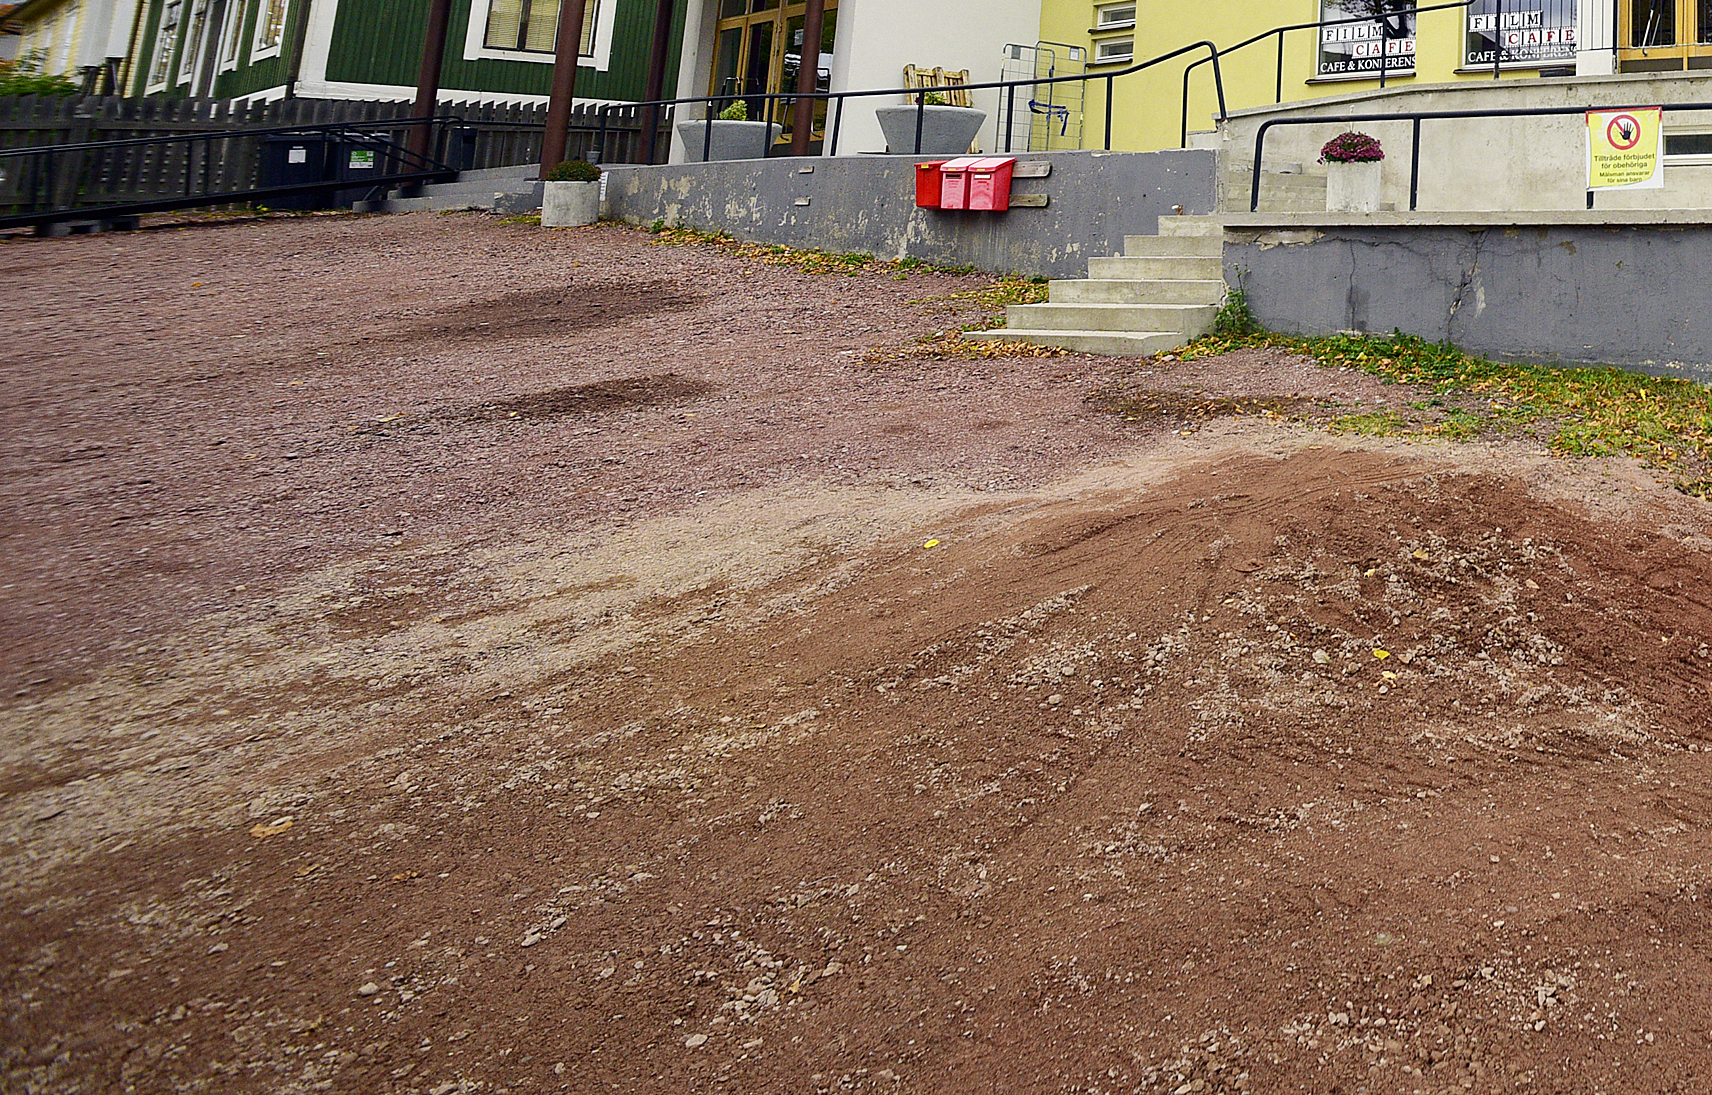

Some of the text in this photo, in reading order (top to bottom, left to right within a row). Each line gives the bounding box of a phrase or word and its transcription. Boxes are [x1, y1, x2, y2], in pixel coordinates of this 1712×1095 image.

[1326, 26, 1383, 41] FILM
[1508, 29, 1575, 44] CAFE
[1356, 40, 1414, 55] CAFE
[1500, 50, 1509, 61] &
[1320, 61, 1346, 73] CAFE
[1347, 60, 1356, 71] &
[1594, 153, 1655, 162] Tillträde förbjudet
[1613, 161, 1648, 169] obehöriga
